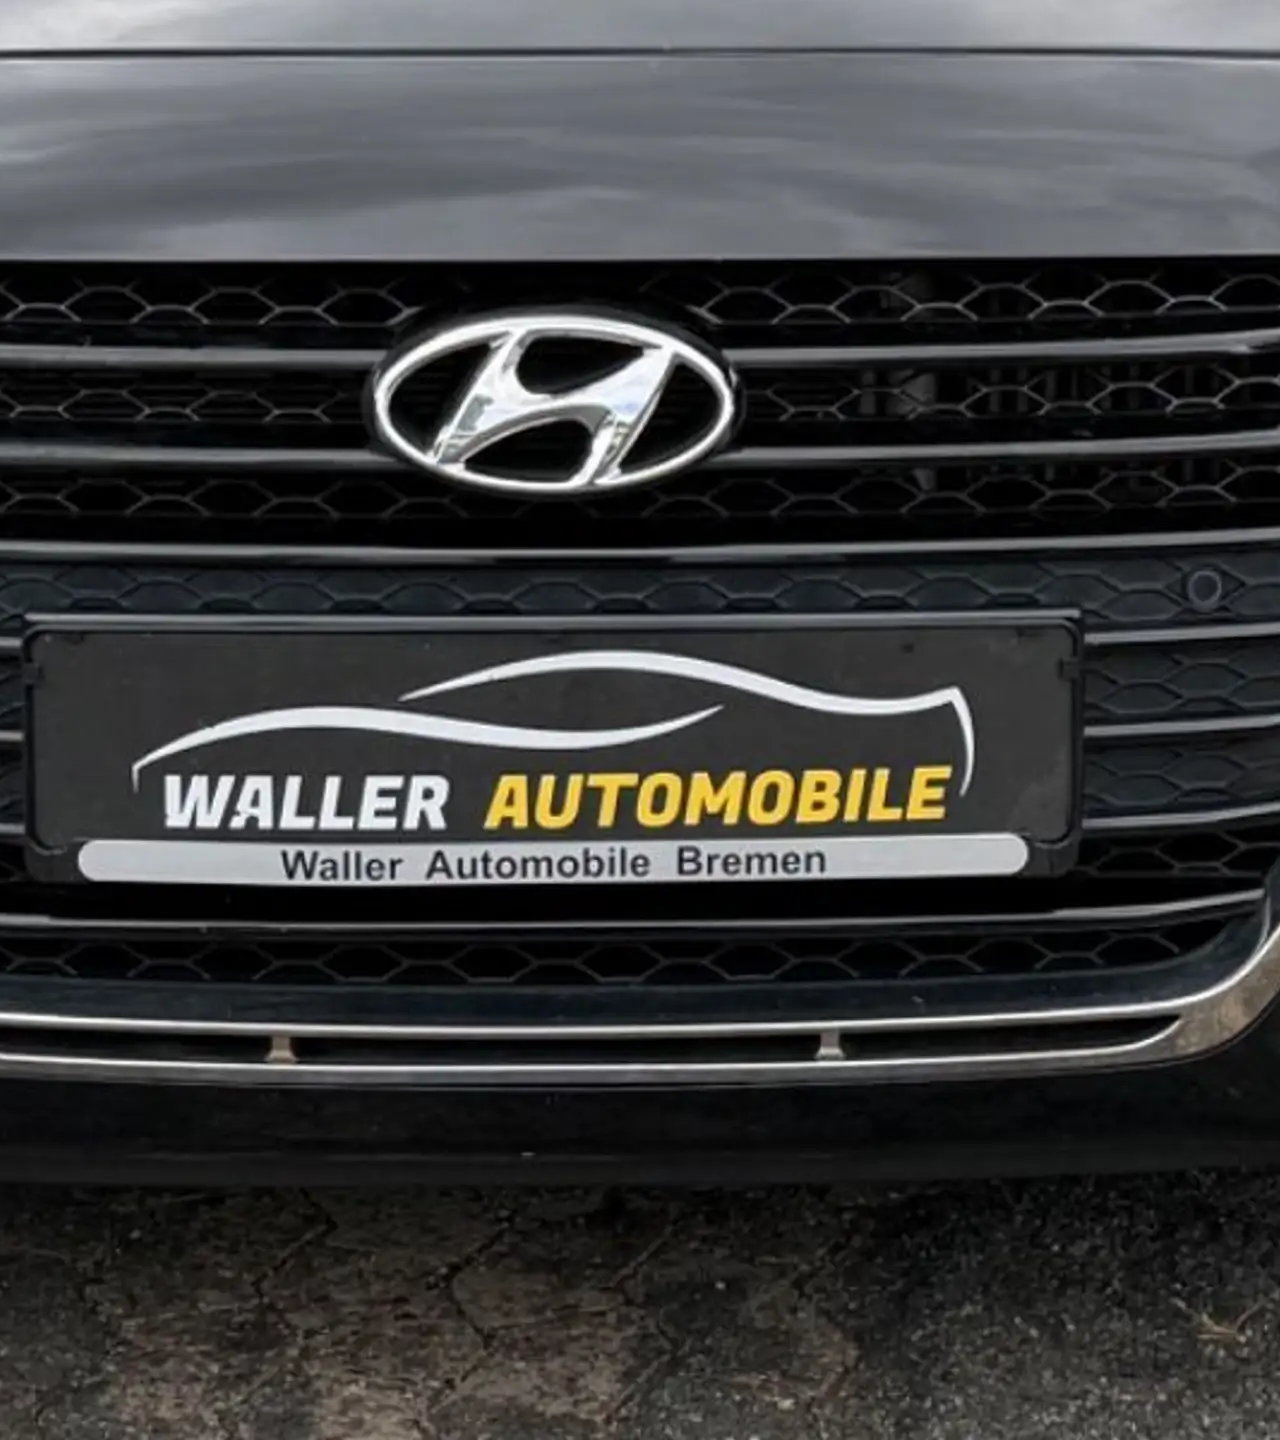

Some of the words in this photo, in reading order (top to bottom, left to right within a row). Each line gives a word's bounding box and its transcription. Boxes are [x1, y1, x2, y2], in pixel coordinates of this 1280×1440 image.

[163, 774, 452, 831] WALLER
[482, 765, 953, 830] AUTOMOBILE
[281, 849, 404, 882] Waller
[426, 846, 652, 881] Automobile
[676, 845, 828, 877] Bremen
